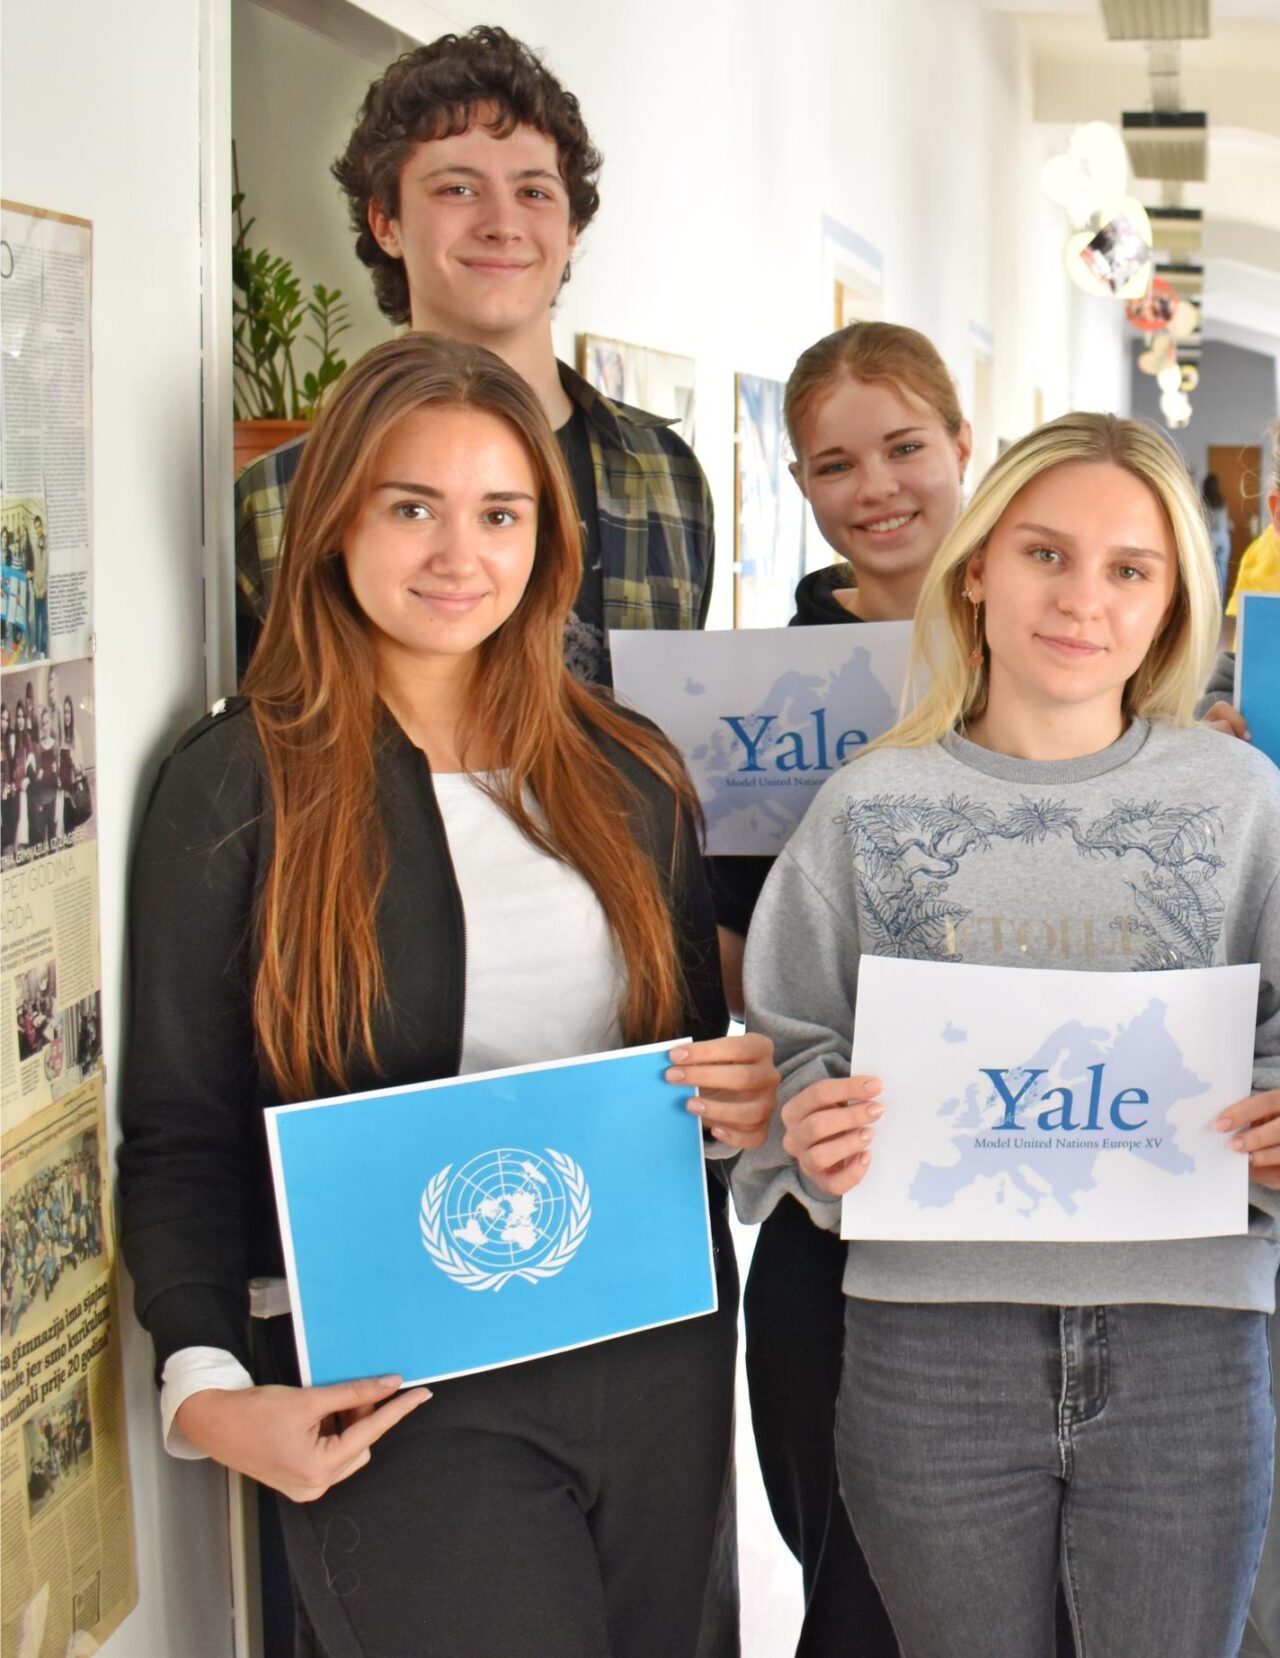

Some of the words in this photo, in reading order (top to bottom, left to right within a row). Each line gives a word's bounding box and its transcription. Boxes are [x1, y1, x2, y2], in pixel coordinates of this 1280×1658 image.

[719, 708, 868, 772] Yale
[726, 777, 756, 788] Model
[758, 777, 792, 787] United
[794, 776, 828, 786] Nation
[29, 853, 77, 892] GODINA
[979, 1063, 1150, 1131] Yale
[974, 1137, 1011, 1149] Model
[1013, 1137, 1052, 1149] United
[1056, 1138, 1099, 1149] Nations
[1102, 1138, 1143, 1151] Europe
[1144, 1138, 1163, 1149] XV
[12, 1316, 65, 1371] gimnazija
[65, 1308, 82, 1328] ima
[26, 1358, 42, 1387] jer
[44, 1343, 67, 1369] smo
[41, 1368, 67, 1404] prije
[67, 1353, 80, 1380] 20
